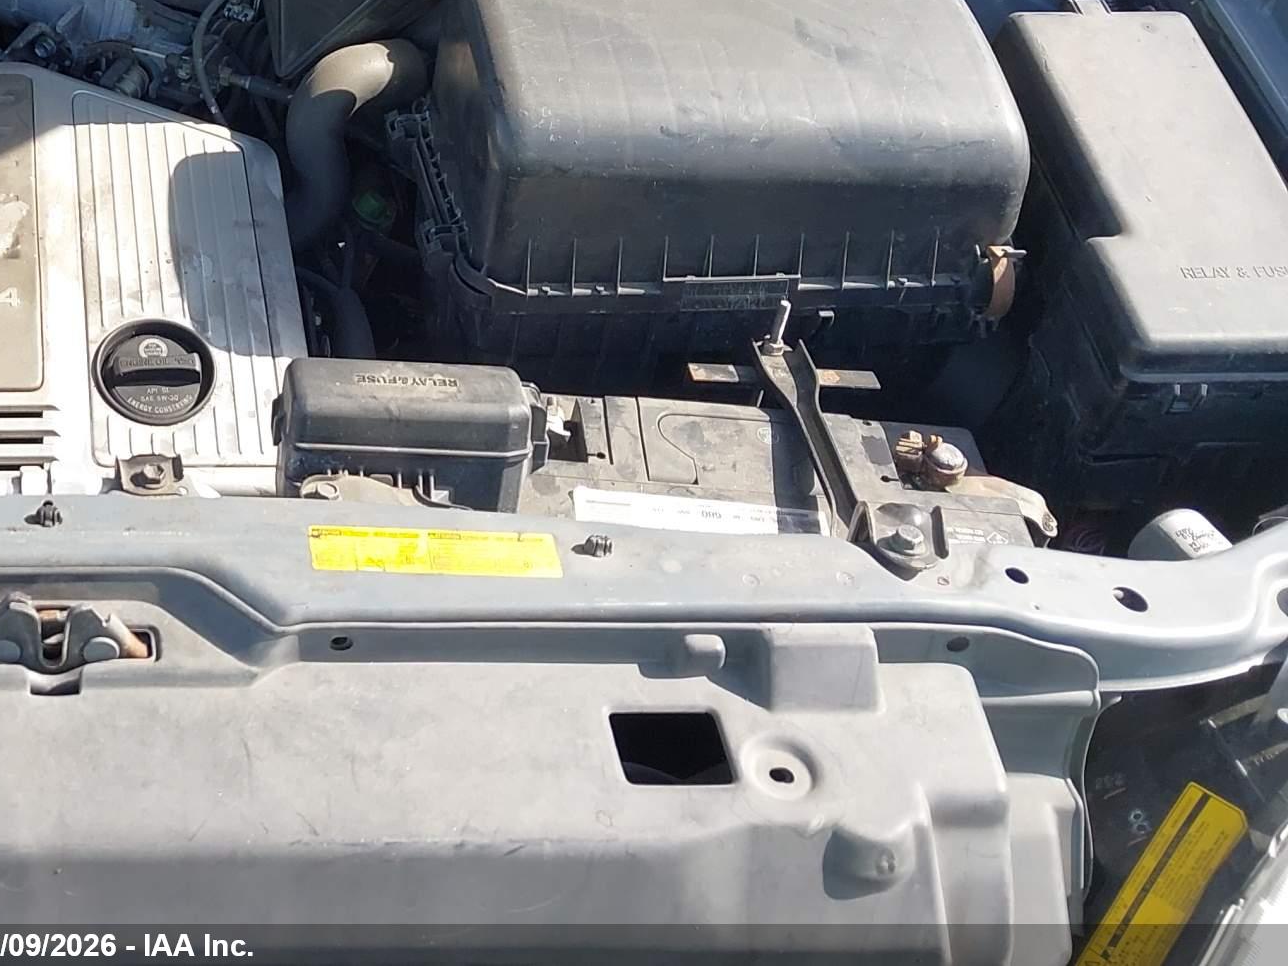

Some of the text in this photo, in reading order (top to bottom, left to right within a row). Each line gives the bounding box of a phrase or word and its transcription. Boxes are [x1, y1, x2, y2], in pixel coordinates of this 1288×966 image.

[1179, 266, 1231, 279] RELAY
[1236, 266, 1251, 278] &
[127, 396, 153, 413] ENERGY
